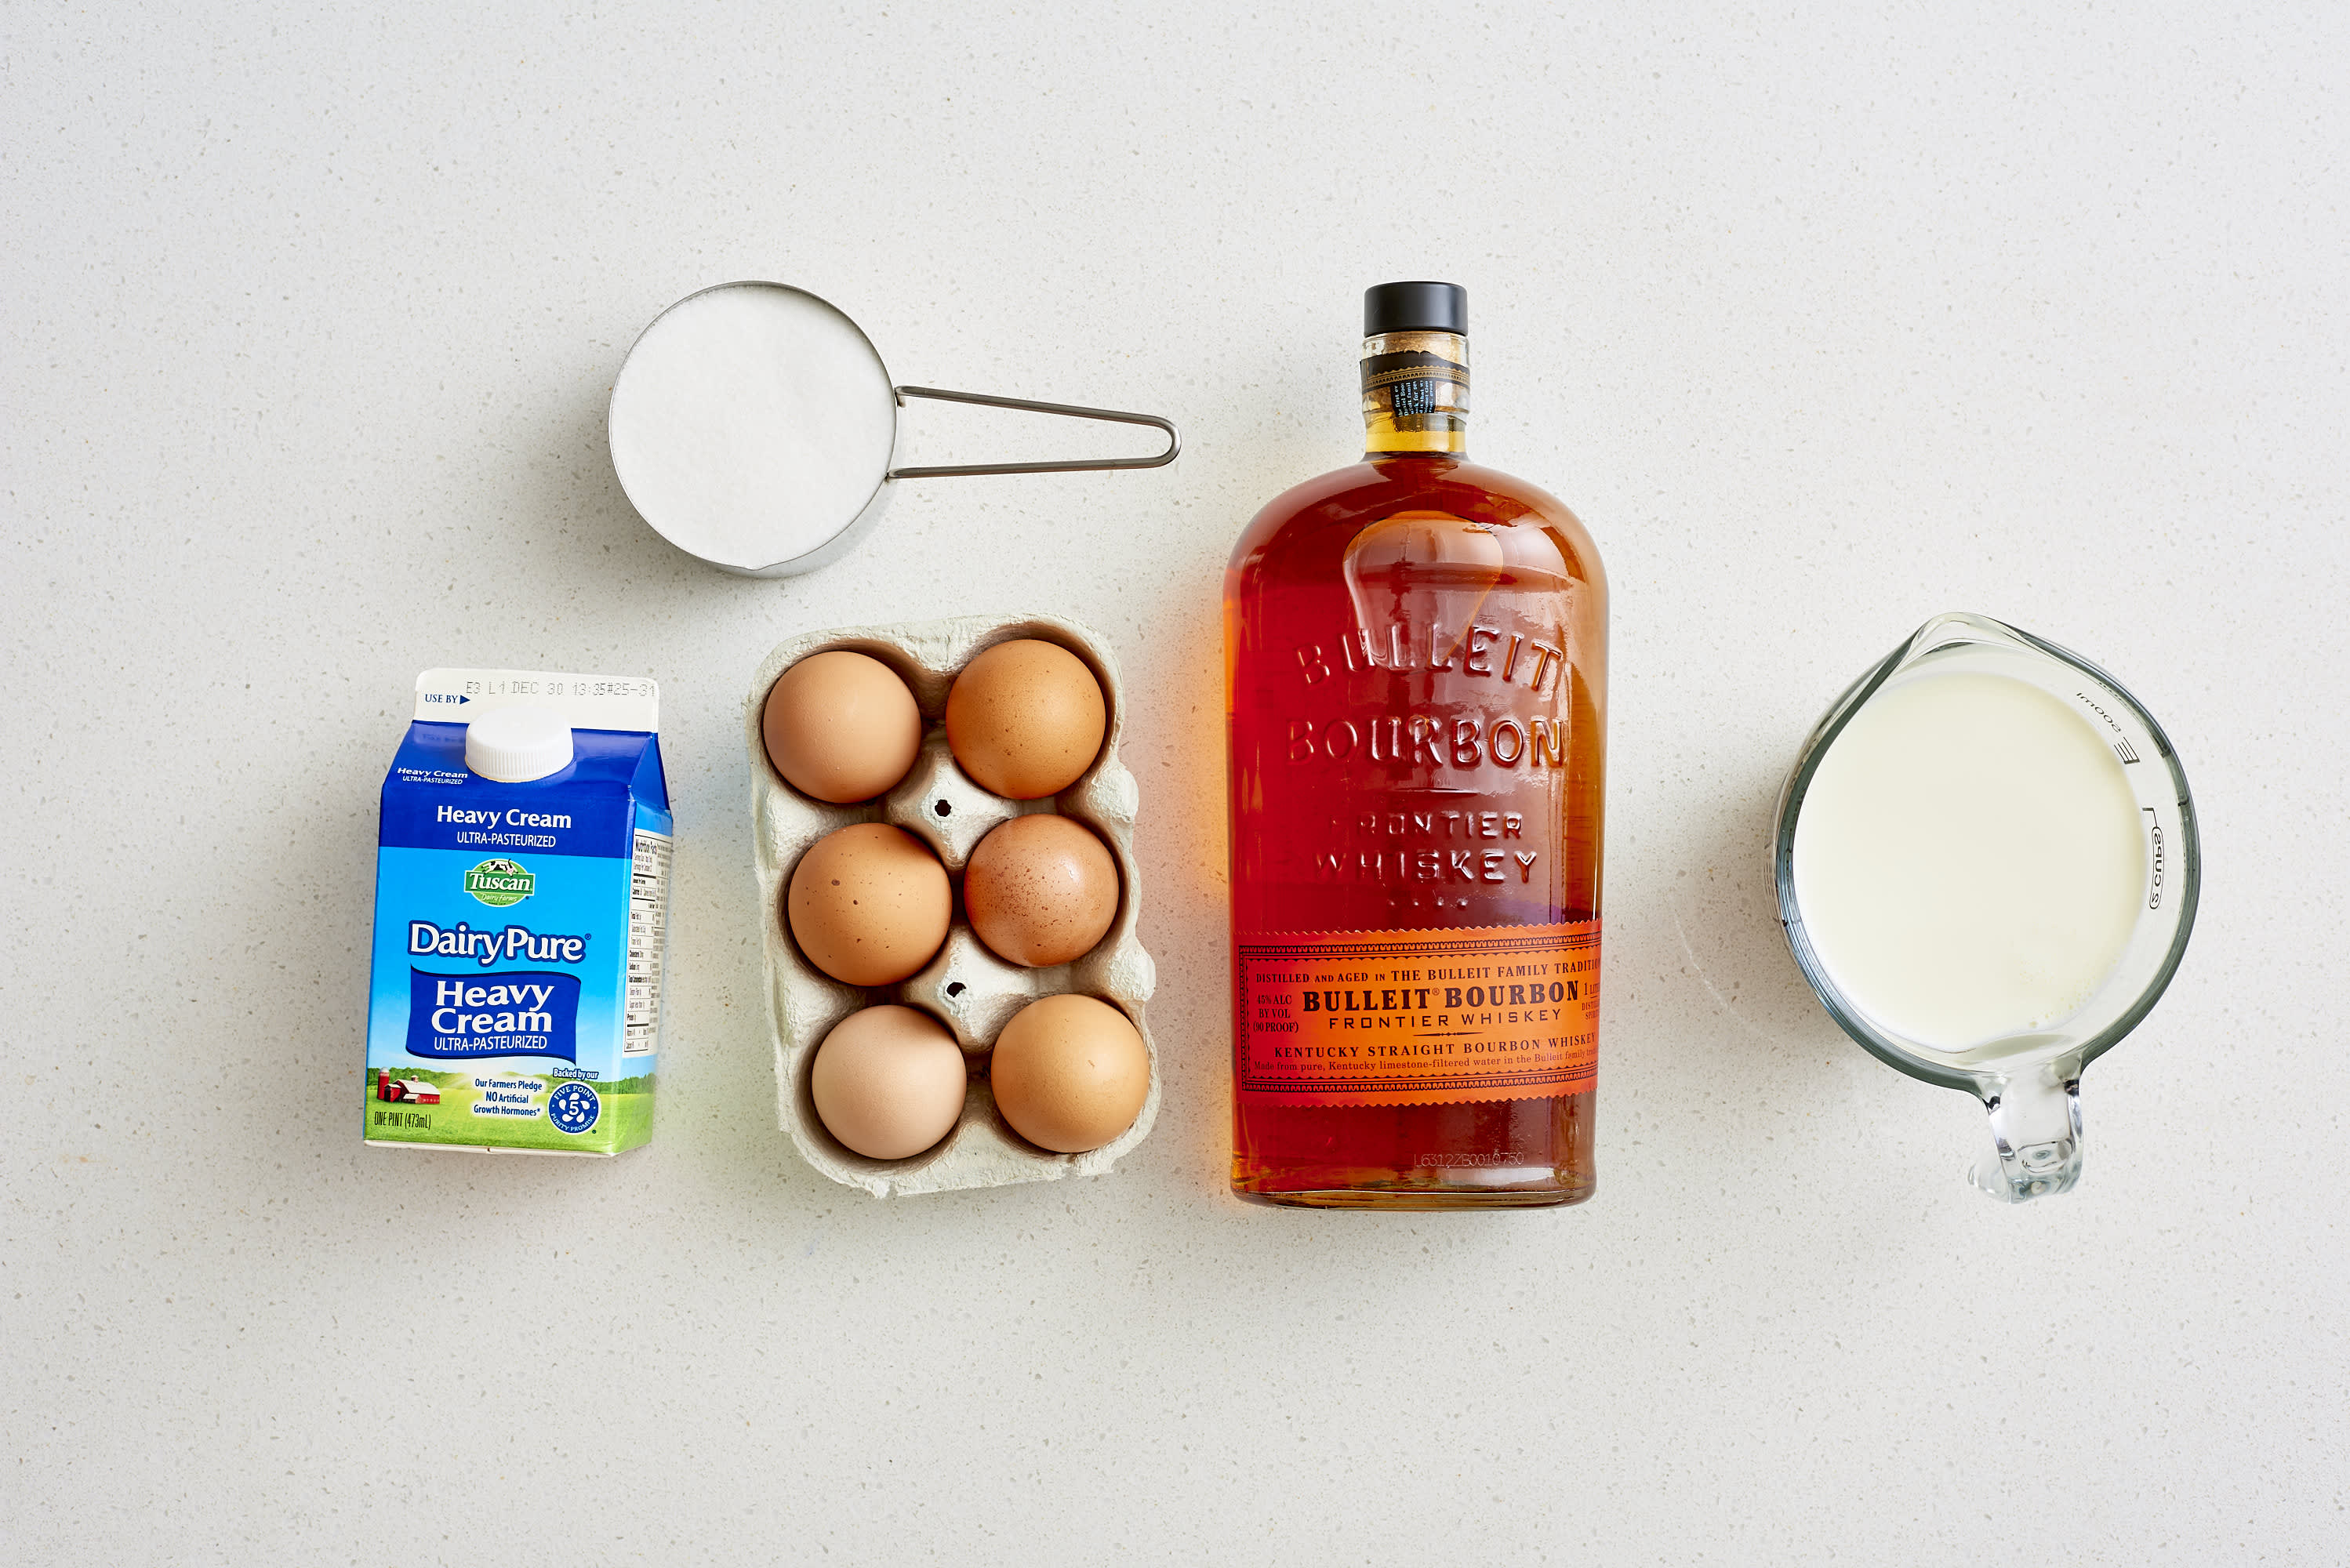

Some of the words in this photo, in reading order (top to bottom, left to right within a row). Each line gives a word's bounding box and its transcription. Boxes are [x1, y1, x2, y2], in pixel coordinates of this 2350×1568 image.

[1297, 623, 1562, 691] BULLEIT
[466, 681, 481, 694] E3
[510, 681, 539, 695] DEC
[548, 683, 563, 695] 30
[425, 694, 443, 703] USE
[445, 695, 458, 704] BY
[1287, 715, 1567, 767] BOURBON
[397, 767, 431, 778] Heavy
[434, 770, 468, 779] Cream
[402, 775, 463, 785] ULTRA-PASTEURIZED
[437, 805, 502, 829] Heavy
[506, 808, 572, 829] Cream
[457, 831, 556, 848] ULTRA-PASTEURIZED
[1315, 851, 1537, 884] WHISKEY
[470, 873, 530, 891] Tuscan
[481, 893, 498, 902] Dairy
[499, 894, 518, 902] Farms
[1256, 973, 1309, 983] DISTILLED
[1314, 975, 1334, 983] AND
[1337, 972, 1368, 982] AGED
[1391, 970, 1421, 981] THE
[1428, 967, 1490, 980] BULLEIT
[1498, 964, 1549, 978] FAMILY
[436, 980, 555, 1012] Heavy
[1256, 994, 1272, 1004] 45%
[1273, 994, 1292, 1005] ALC
[1444, 980, 1579, 1008] BOURBON
[431, 1007, 553, 1034] Cream
[1259, 1009, 1270, 1018] BY
[1272, 1008, 1291, 1018] VOL
[1329, 1014, 1448, 1029] FRONTIER
[1462, 1008, 1561, 1025] WHISKEY
[1253, 1022, 1264, 1033] (90
[1266, 1021, 1298, 1033] PROOF)
[434, 1035, 547, 1052] ULTRA-PASTEURIZED
[1274, 1047, 1359, 1058] KENTUCKY
[1368, 1044, 1455, 1057] STRAIGHT
[1464, 1039, 1540, 1054] BOURBON
[1549, 1032, 1595, 1048] WHISKEY
[1255, 1062, 1274, 1071] Made
[1277, 1062, 1297, 1071] from
[1301, 1063, 1325, 1073] pure,
[1329, 1061, 1376, 1072] Kentucky
[1379, 1058, 1469, 1069] limestone-filtered
[1473, 1057, 1500, 1066] water
[1504, 1056, 1513, 1065] in
[1516, 1054, 1531, 1064] the
[1535, 1052, 1562, 1063] Bulleit
[1565, 1050, 1585, 1060] family
[554, 1069, 577, 1078] Backed
[578, 1069, 586, 1080] by
[475, 1078, 488, 1087] Our
[489, 1079, 517, 1090] Farmers
[518, 1080, 543, 1092] Pledge
[485, 1091, 498, 1102] NO
[499, 1094, 528, 1104] Artificial
[554, 1086, 571, 1100] FIVE
[573, 1086, 596, 1102] POINT
[474, 1105, 499, 1115] Growth
[568, 1101, 579, 1116] 5
[375, 1111, 387, 1126] ONE
[388, 1112, 403, 1127] PINT
[405, 1113, 431, 1130] (473mL)
[551, 1113, 569, 1131] PURITY
[570, 1114, 595, 1131] PROMISE
